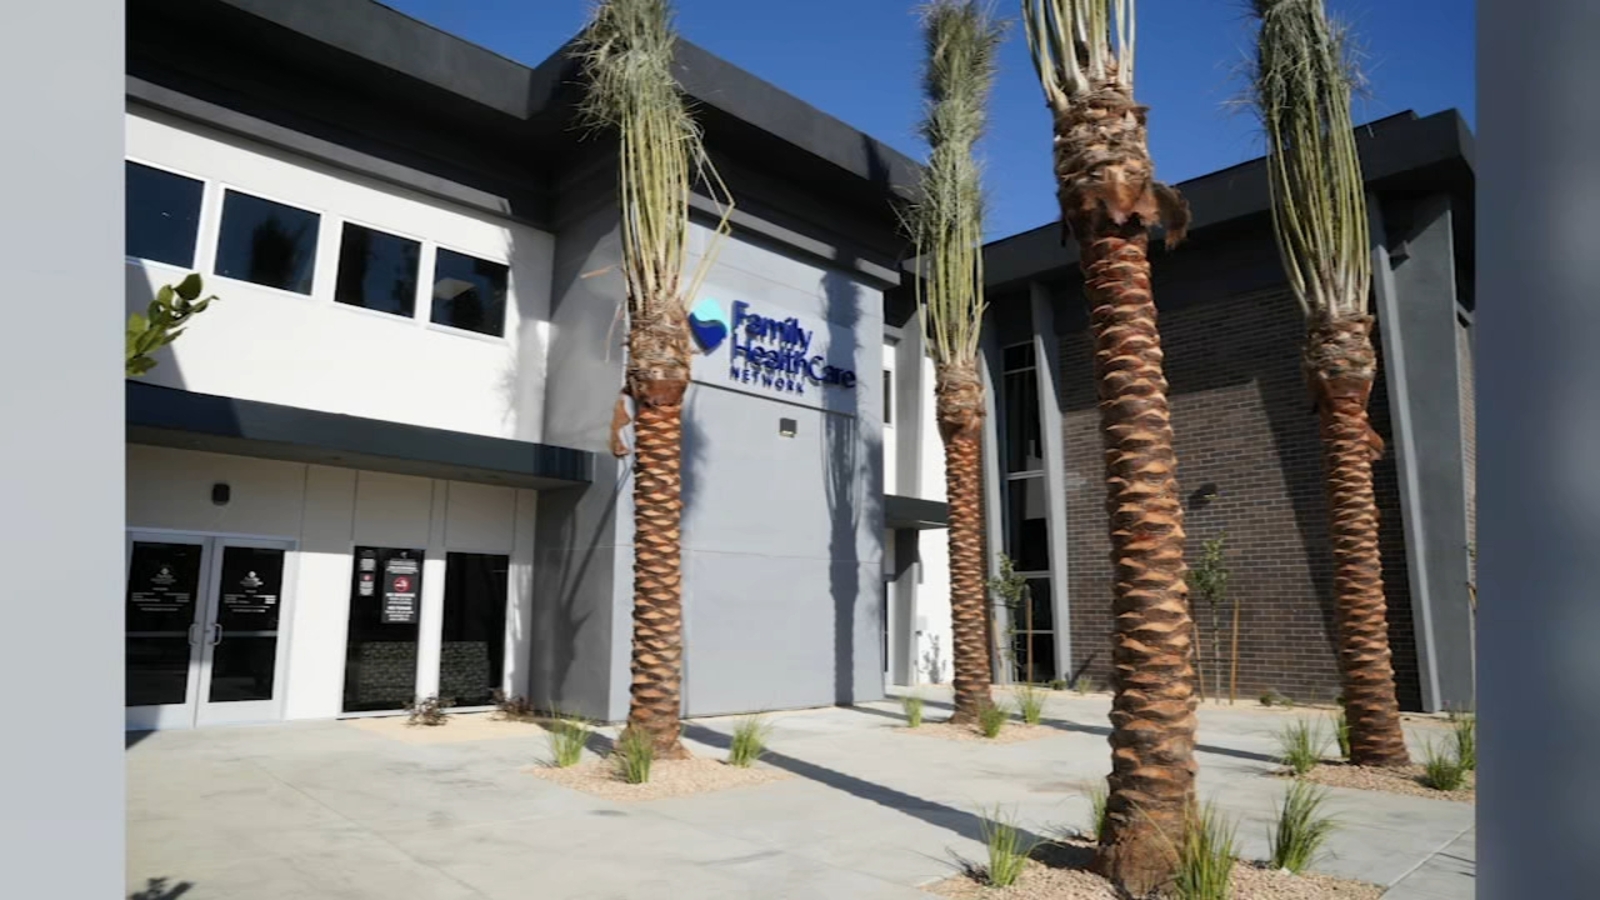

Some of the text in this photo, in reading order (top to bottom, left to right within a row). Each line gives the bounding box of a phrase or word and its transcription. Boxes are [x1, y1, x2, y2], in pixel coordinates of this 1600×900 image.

[732, 301, 813, 354] Family
[731, 334, 856, 388] HealthCare
[731, 368, 805, 395] NETWORK
